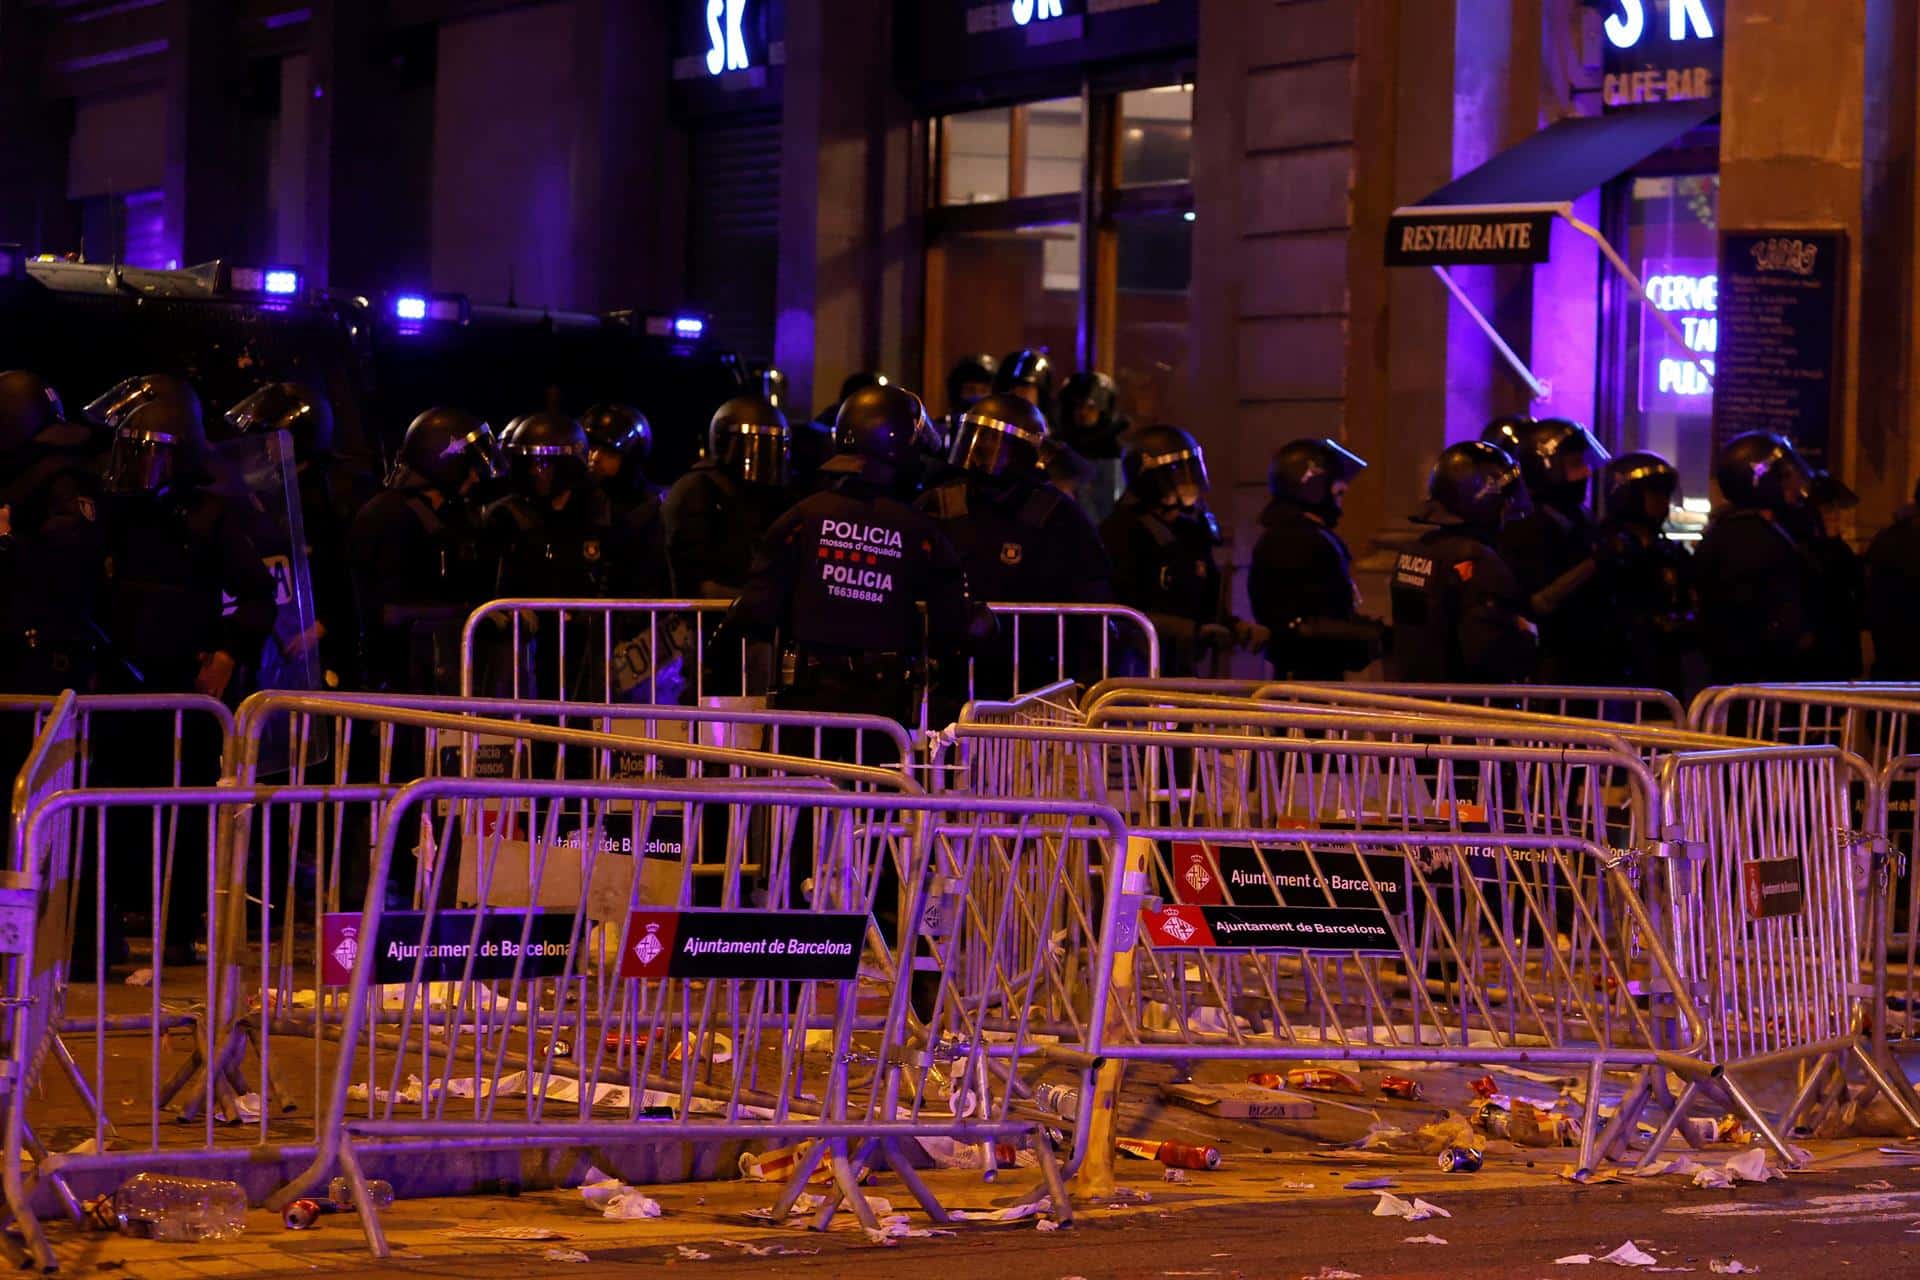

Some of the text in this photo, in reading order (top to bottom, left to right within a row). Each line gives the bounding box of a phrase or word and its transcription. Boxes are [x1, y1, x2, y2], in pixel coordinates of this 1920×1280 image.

[706, 0, 749, 75] SK
[1402, 222, 1532, 252] RESTAURANTE
[822, 519, 903, 548] POLICIA
[820, 538, 902, 559] mossos d'esquadra
[822, 563, 893, 592] POLICIA
[605, 837, 620, 852] de
[622, 838, 681, 854] Bcelona
[1231, 869, 1311, 888] Ajuntment
[1331, 875, 1397, 893] Barceona
[1216, 921, 1386, 935] Ajuntament de Barcelona
[387, 940, 571, 961] Ajunamen de Bacelon
[683, 937, 852, 956] Ajuntament de Barcelona
